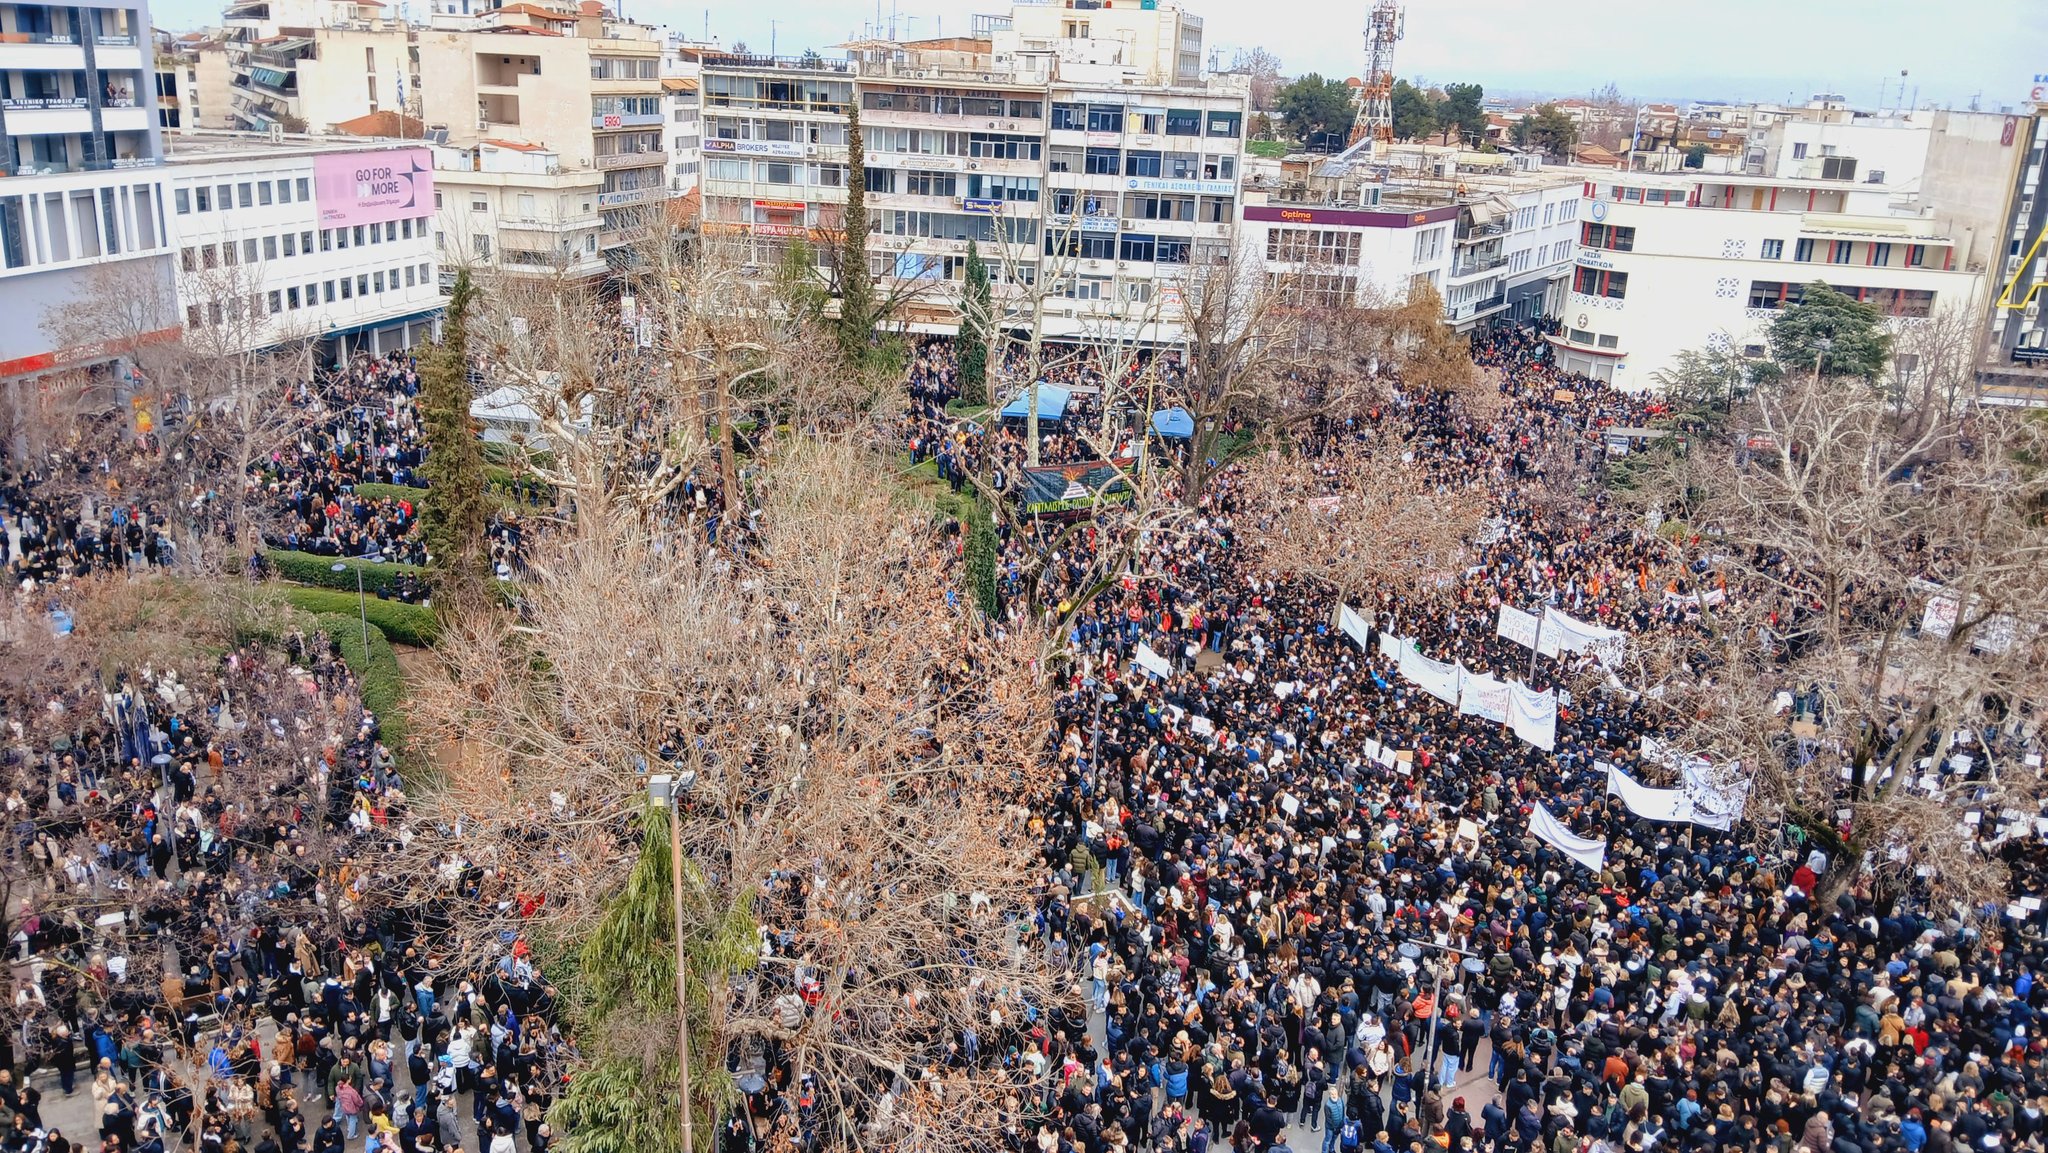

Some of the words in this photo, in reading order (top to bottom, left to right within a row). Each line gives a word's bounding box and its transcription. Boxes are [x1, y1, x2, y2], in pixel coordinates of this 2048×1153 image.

[604, 115, 621, 127] ERGO
[711, 142, 734, 150] ALPHA
[737, 143, 768, 152] BROKERS
[356, 169, 371, 181] GO
[373, 167, 391, 180] FOR
[371, 181, 399, 196] MORE
[1281, 210, 1312, 220] Optima
